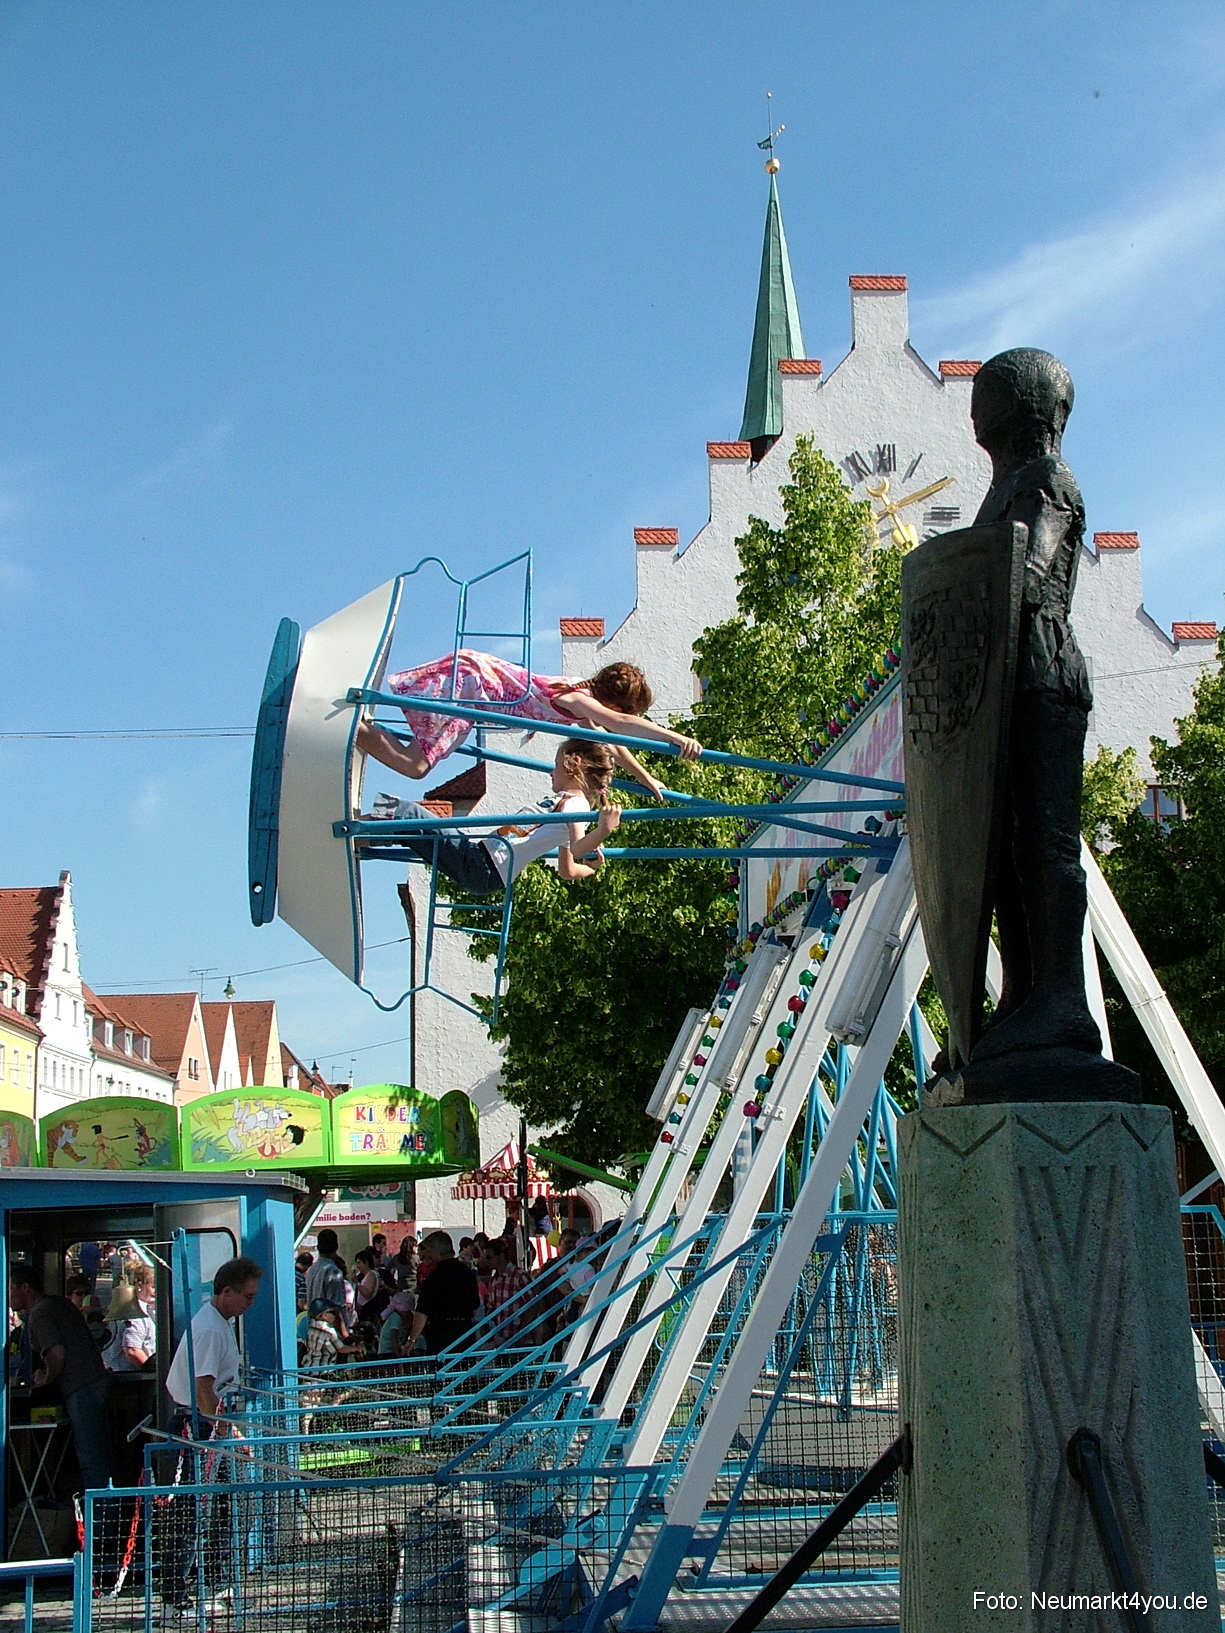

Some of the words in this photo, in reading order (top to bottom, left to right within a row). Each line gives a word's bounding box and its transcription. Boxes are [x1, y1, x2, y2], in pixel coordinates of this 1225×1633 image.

[355, 1105, 421, 1123] KINDER
[350, 1128, 425, 1151] TRÄUME
[316, 1214, 337, 1222] milie
[339, 1212, 371, 1221] baden?
